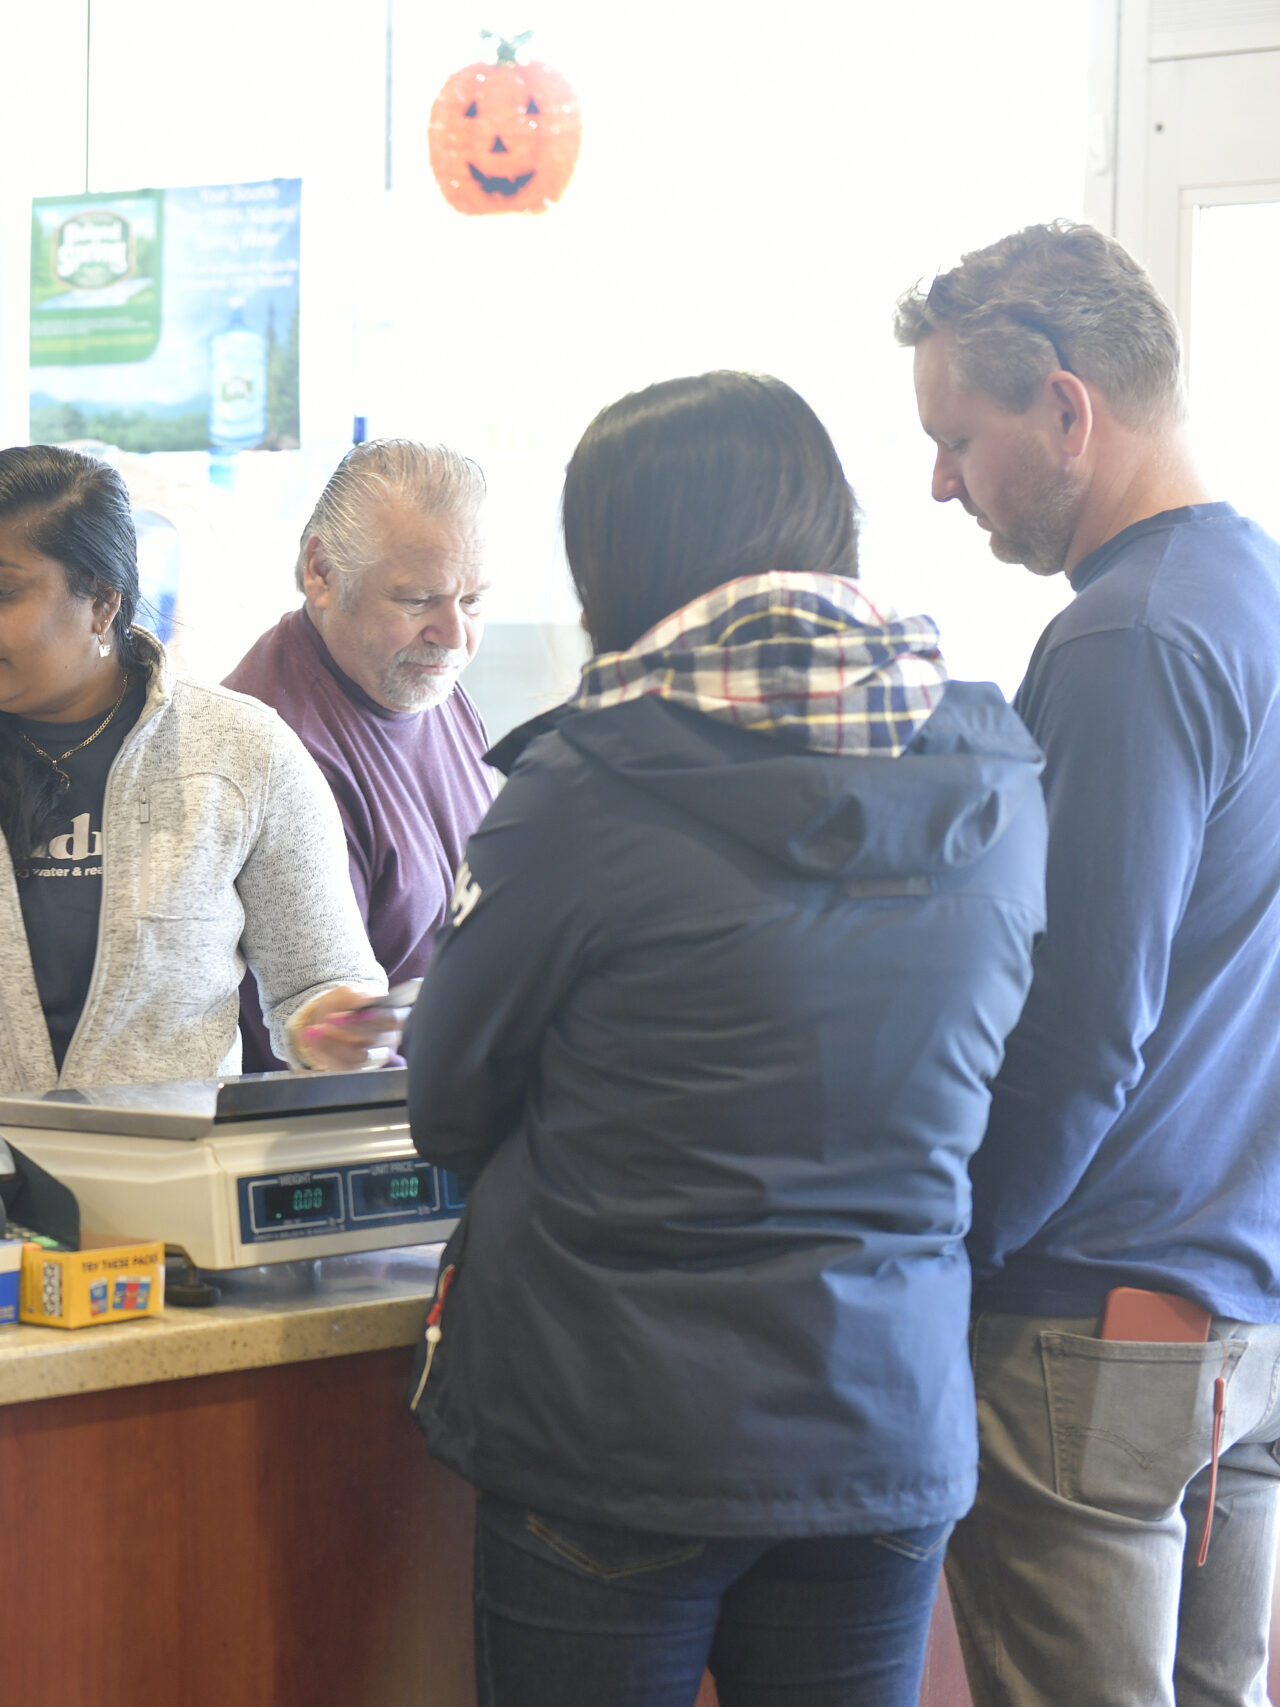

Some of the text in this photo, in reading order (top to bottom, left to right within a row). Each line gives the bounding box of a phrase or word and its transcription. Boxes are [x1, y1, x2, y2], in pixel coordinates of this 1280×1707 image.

[391, 1160, 415, 1172] PRICE
[82, 1261, 99, 1273] TRY
[103, 1257, 129, 1270] THESE
